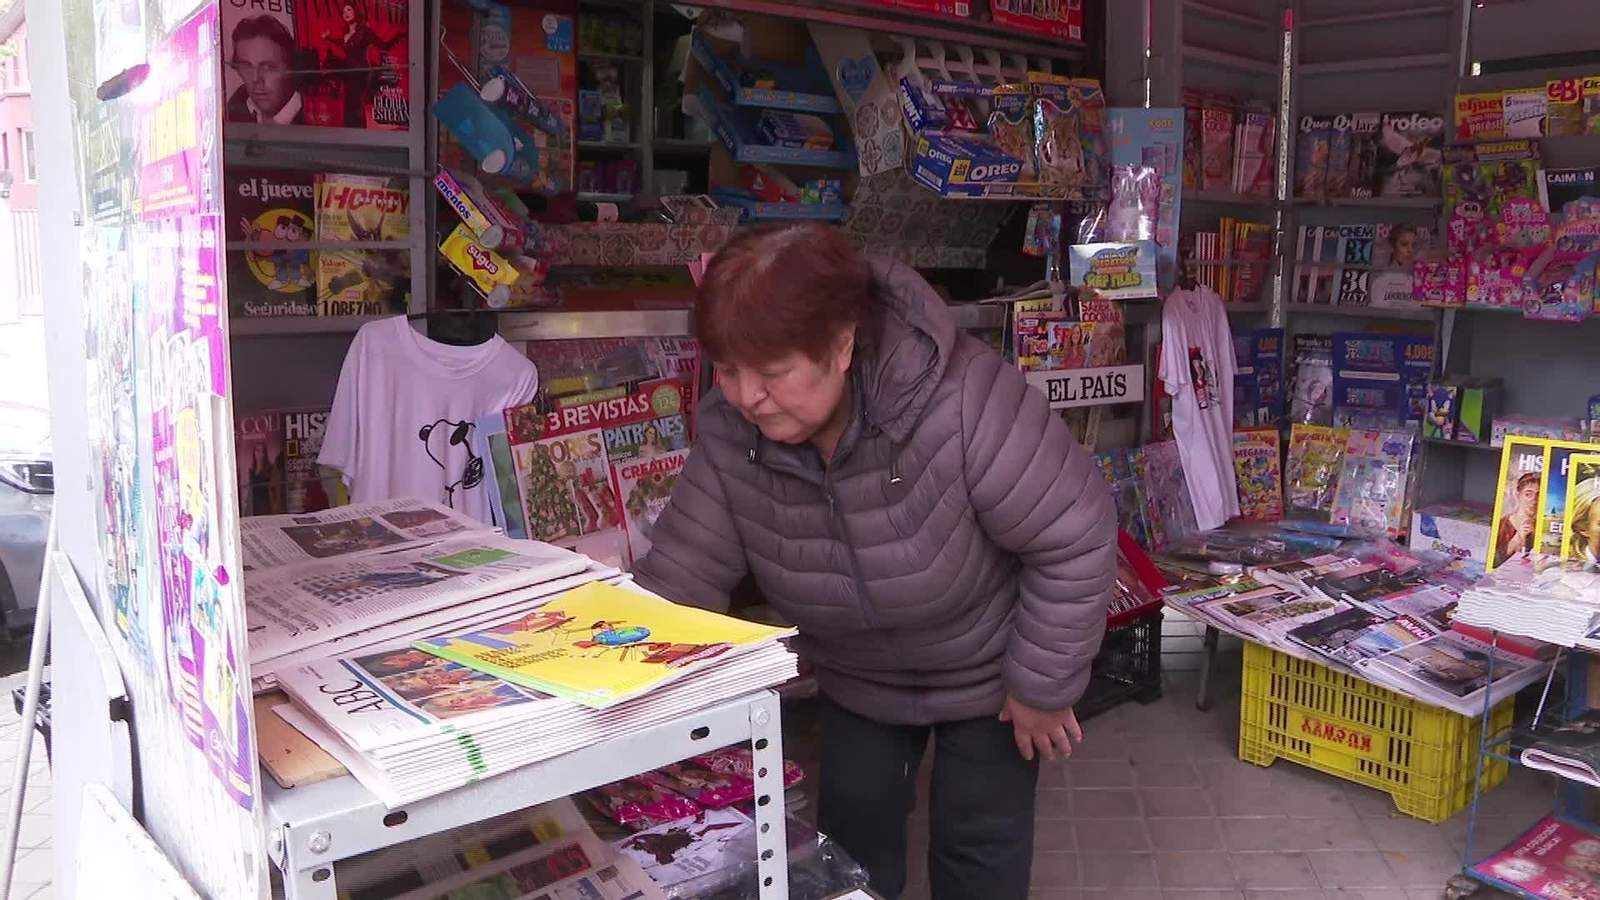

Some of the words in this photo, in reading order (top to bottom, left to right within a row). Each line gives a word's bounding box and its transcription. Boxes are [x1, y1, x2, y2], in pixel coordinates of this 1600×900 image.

[1384, 113, 1444, 131] trofeo
[970, 162, 1020, 181] OREO
[239, 179, 257, 197] el
[437, 180, 471, 220] mentos
[467, 244, 498, 274] sugus
[1046, 378, 1077, 402] EL
[1080, 371, 1127, 400] PAÍS
[547, 412, 561, 430] 3
[563, 393, 650, 428] REVISTAS
[622, 454, 686, 481] CREATIVA
[319, 680, 385, 715] ABC
